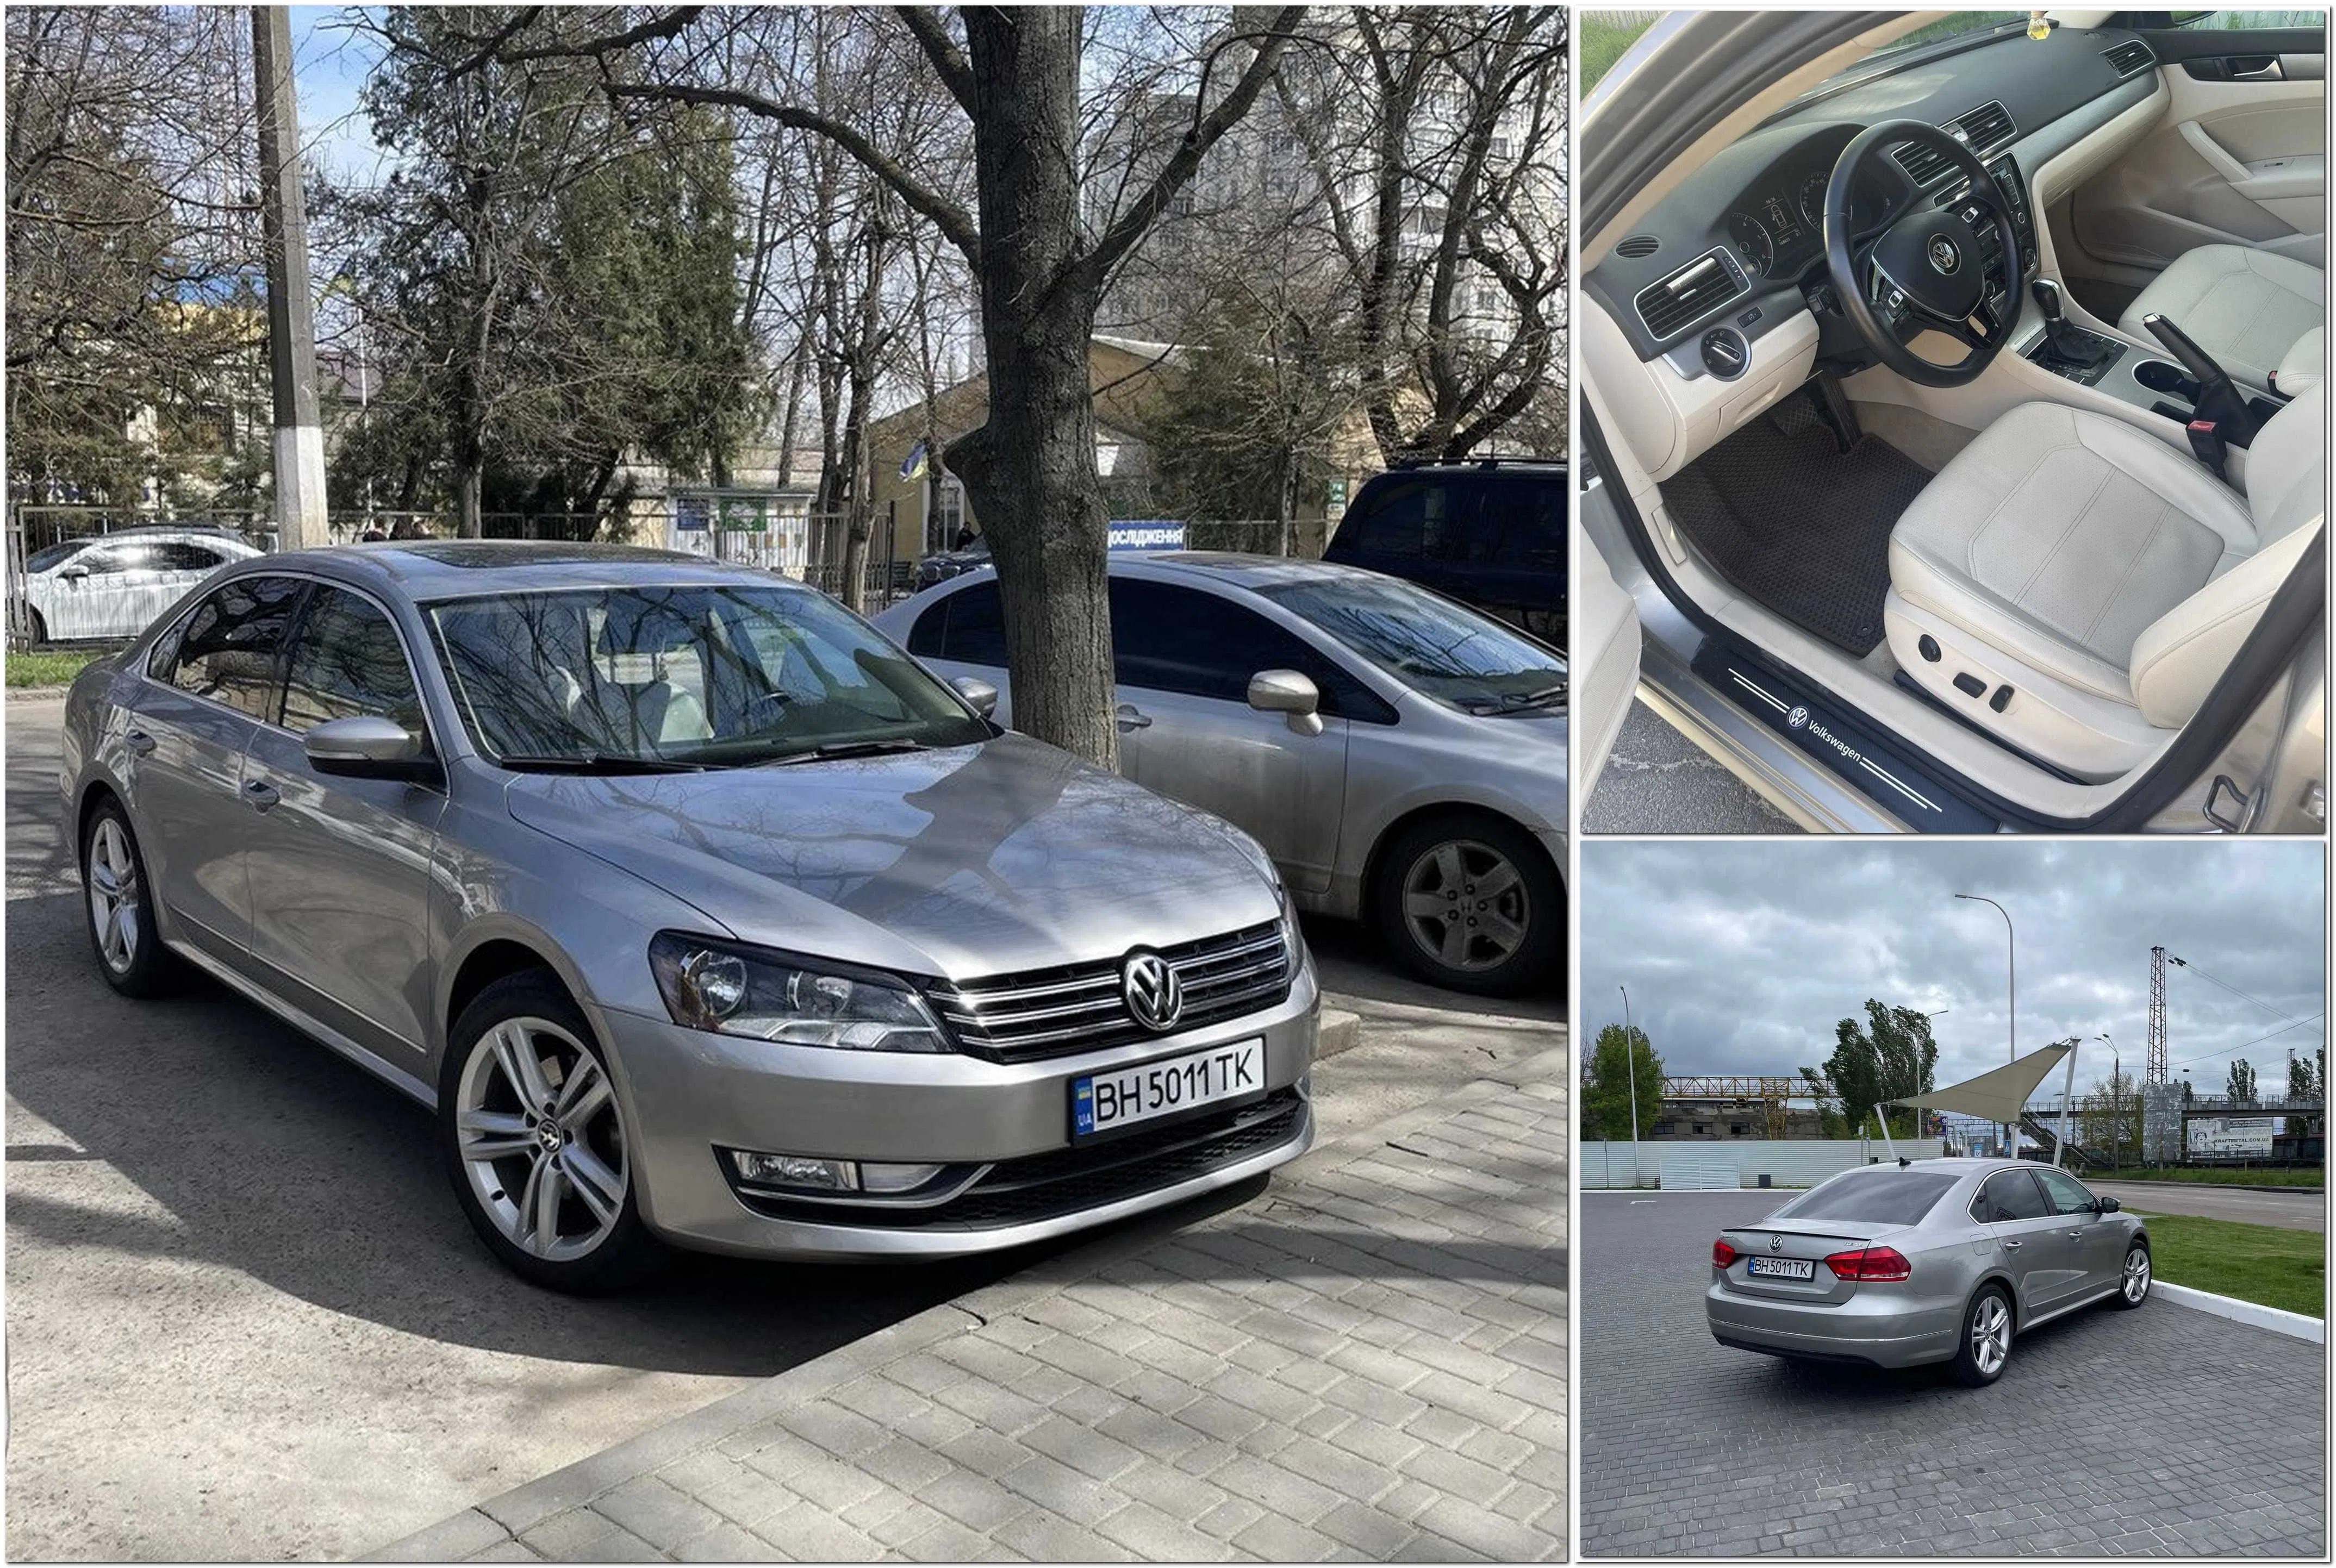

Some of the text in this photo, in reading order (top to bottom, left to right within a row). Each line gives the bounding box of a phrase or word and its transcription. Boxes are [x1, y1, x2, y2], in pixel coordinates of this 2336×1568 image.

[1788, 707, 1861, 762] VW Volkswagen
[1125, 954, 1182, 1030] VW
[1095, 1048, 1253, 1122] BH 5011 TK
[1077, 1113, 1092, 1127] UA
[1768, 1235, 1783, 1253] VW
[1754, 1259, 1809, 1276] BH 5011 TK
